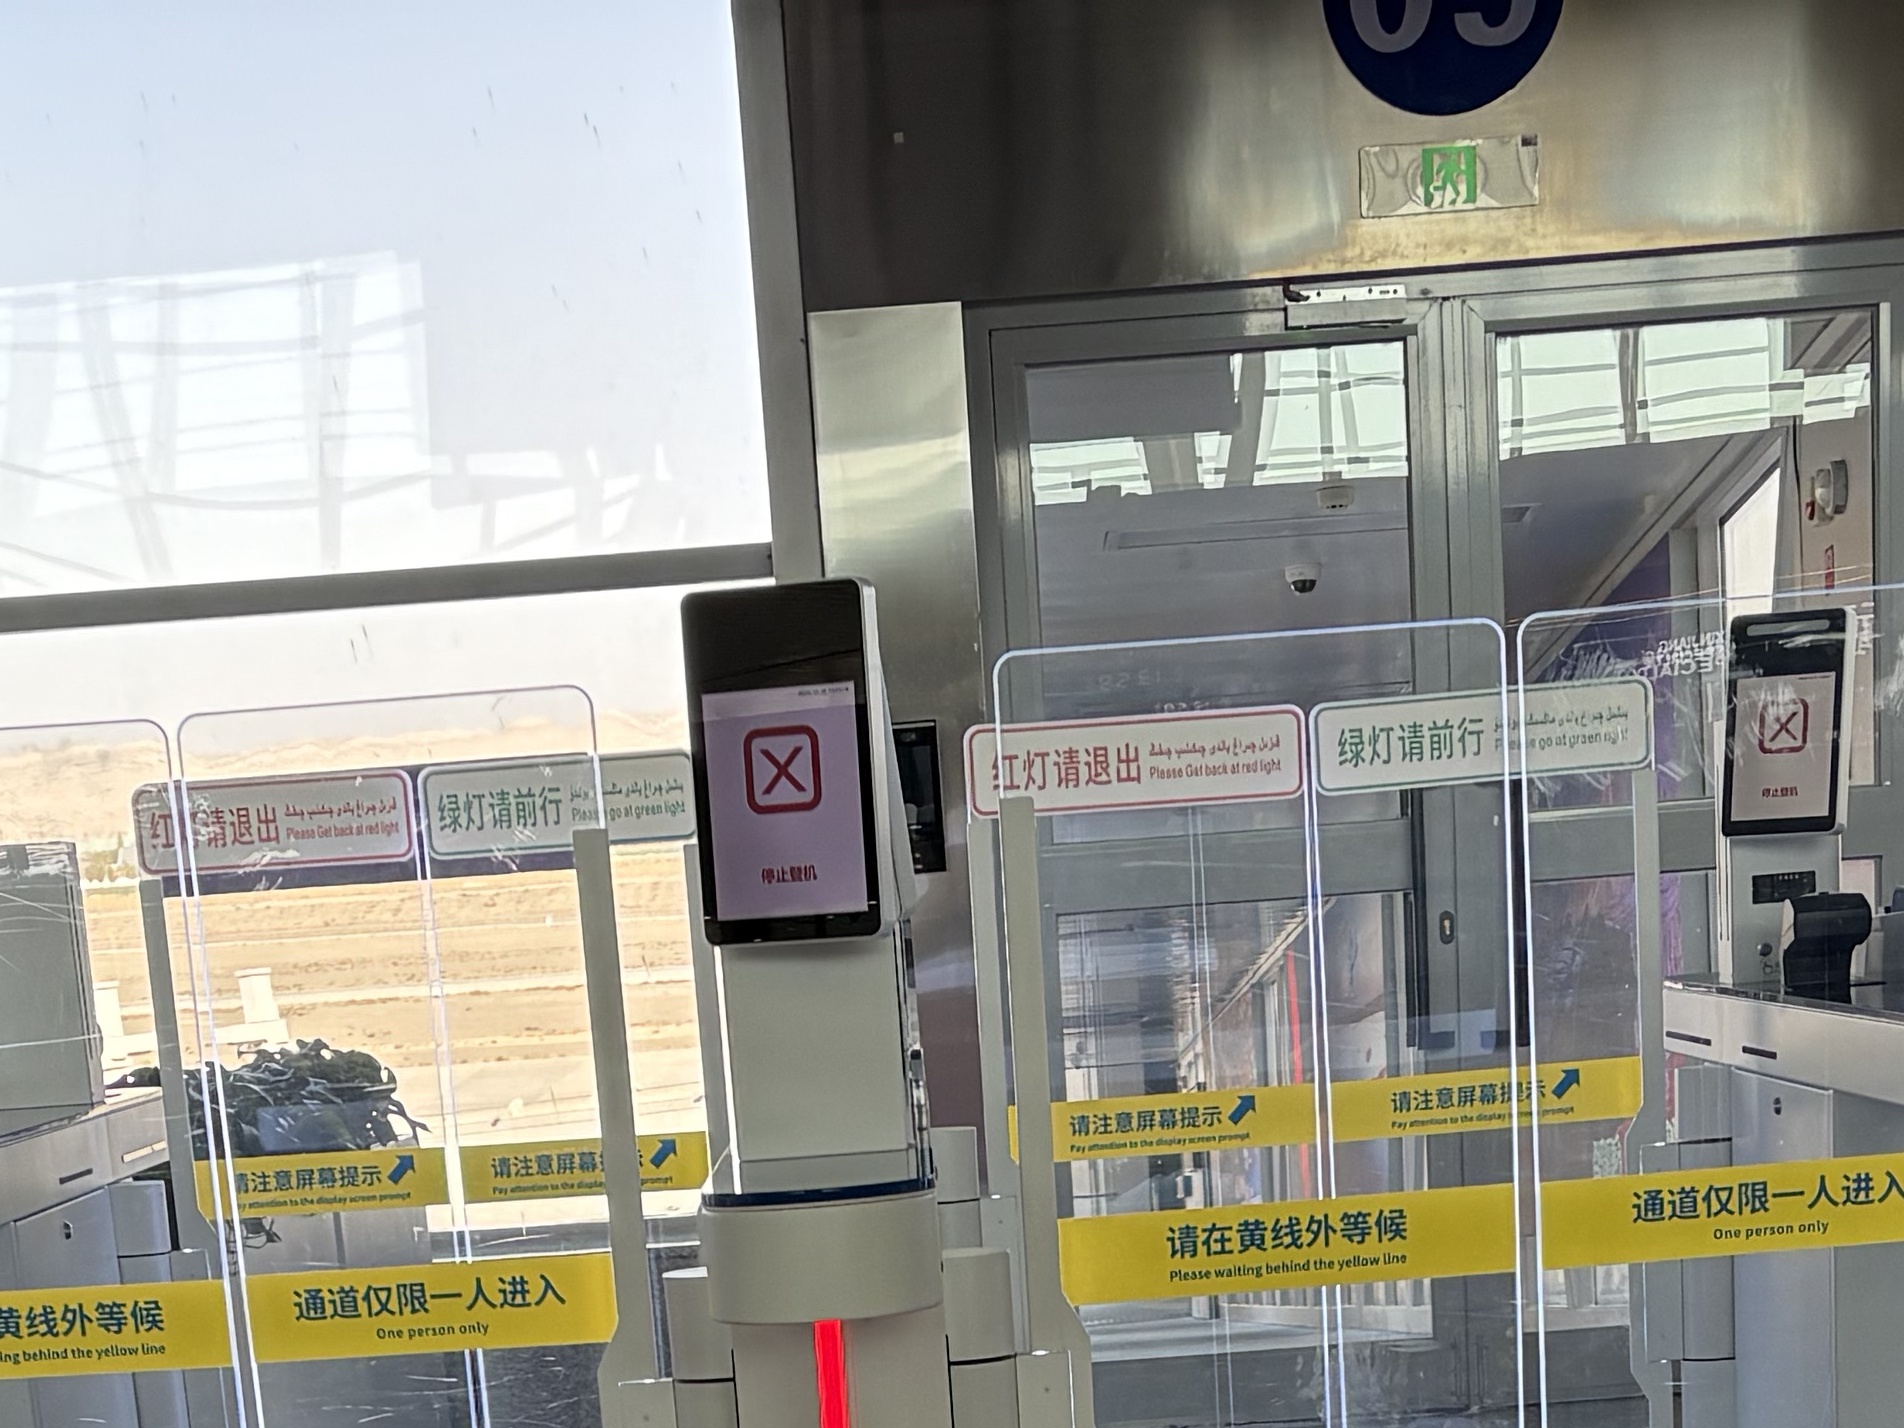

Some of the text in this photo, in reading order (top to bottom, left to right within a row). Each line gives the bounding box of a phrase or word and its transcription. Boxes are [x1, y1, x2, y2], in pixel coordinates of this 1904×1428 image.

[1337, 716, 1485, 768] 绿灯请前行
[991, 742, 1142, 792] 红灯请退出
[1149, 765, 1184, 780] Please
[1241, 760, 1258, 776] red
[437, 785, 563, 833] 绿灯请前行
[635, 803, 663, 820] green
[286, 820, 399, 841] Please Get back at red light
[1391, 1080, 1546, 1113] 请注意屏幕提示
[1070, 1106, 1222, 1137] 请注意屏幕提示
[1450, 1117, 1459, 1125] to
[1460, 1115, 1475, 1124] the
[1070, 1132, 1250, 1154] Pay attention to the display screen prompt
[492, 1186, 508, 1196] Pay
[509, 1184, 549, 1194] attention
[550, 1183, 560, 1191] to
[560, 1181, 575, 1190] the
[248, 1199, 288, 1210] attention
[289, 1198, 299, 1207] to
[300, 1196, 315, 1205] the
[316, 1195, 347, 1207] display
[349, 1193, 377, 1203] screen
[379, 1191, 411, 1202] prompt
[1166, 1208, 1408, 1260] 请在黄线外等候
[1713, 1219, 1830, 1241] One person only
[1169, 1251, 1408, 1283] Please waiting behind the yellow line
[293, 1273, 567, 1322] 通道仅限一人进入
[376, 1321, 490, 1340] One person only
[23, 1347, 68, 1363] behind
[70, 1346, 93, 1360] the
[95, 1344, 139, 1359] yellow
[141, 1342, 167, 1355] line
